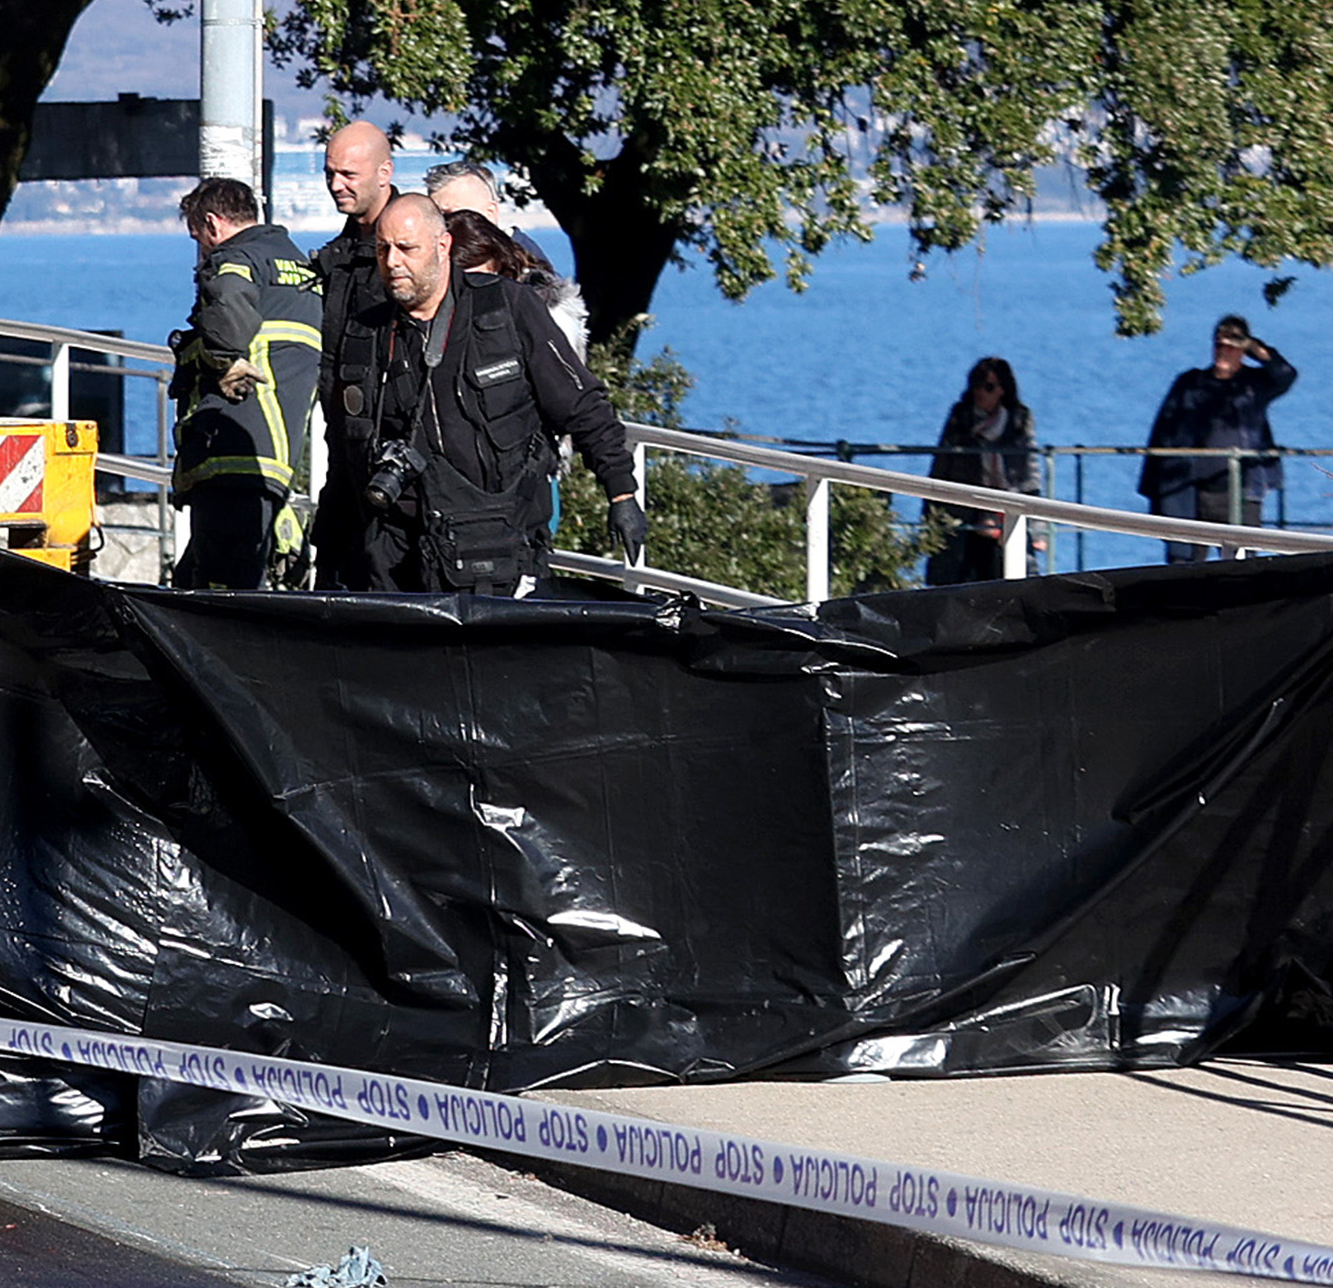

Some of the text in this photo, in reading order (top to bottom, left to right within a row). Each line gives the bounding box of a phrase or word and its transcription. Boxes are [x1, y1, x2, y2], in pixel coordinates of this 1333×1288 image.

[77, 1039, 171, 1080] POLICIJA
[252, 1064, 347, 1111] POLICIJA
[357, 1078, 410, 1122] STOP
[434, 1092, 526, 1143] POLICIJA
[539, 1108, 589, 1154] STOP
[613, 1122, 702, 1175] POLICIJA
[715, 1139, 764, 1186] STOP
[789, 1153, 877, 1208] POLICIJA
[889, 1170, 939, 1219] STOP
[965, 1185, 1050, 1240] POLICIJA
[1060, 1202, 1109, 1250] STOP
